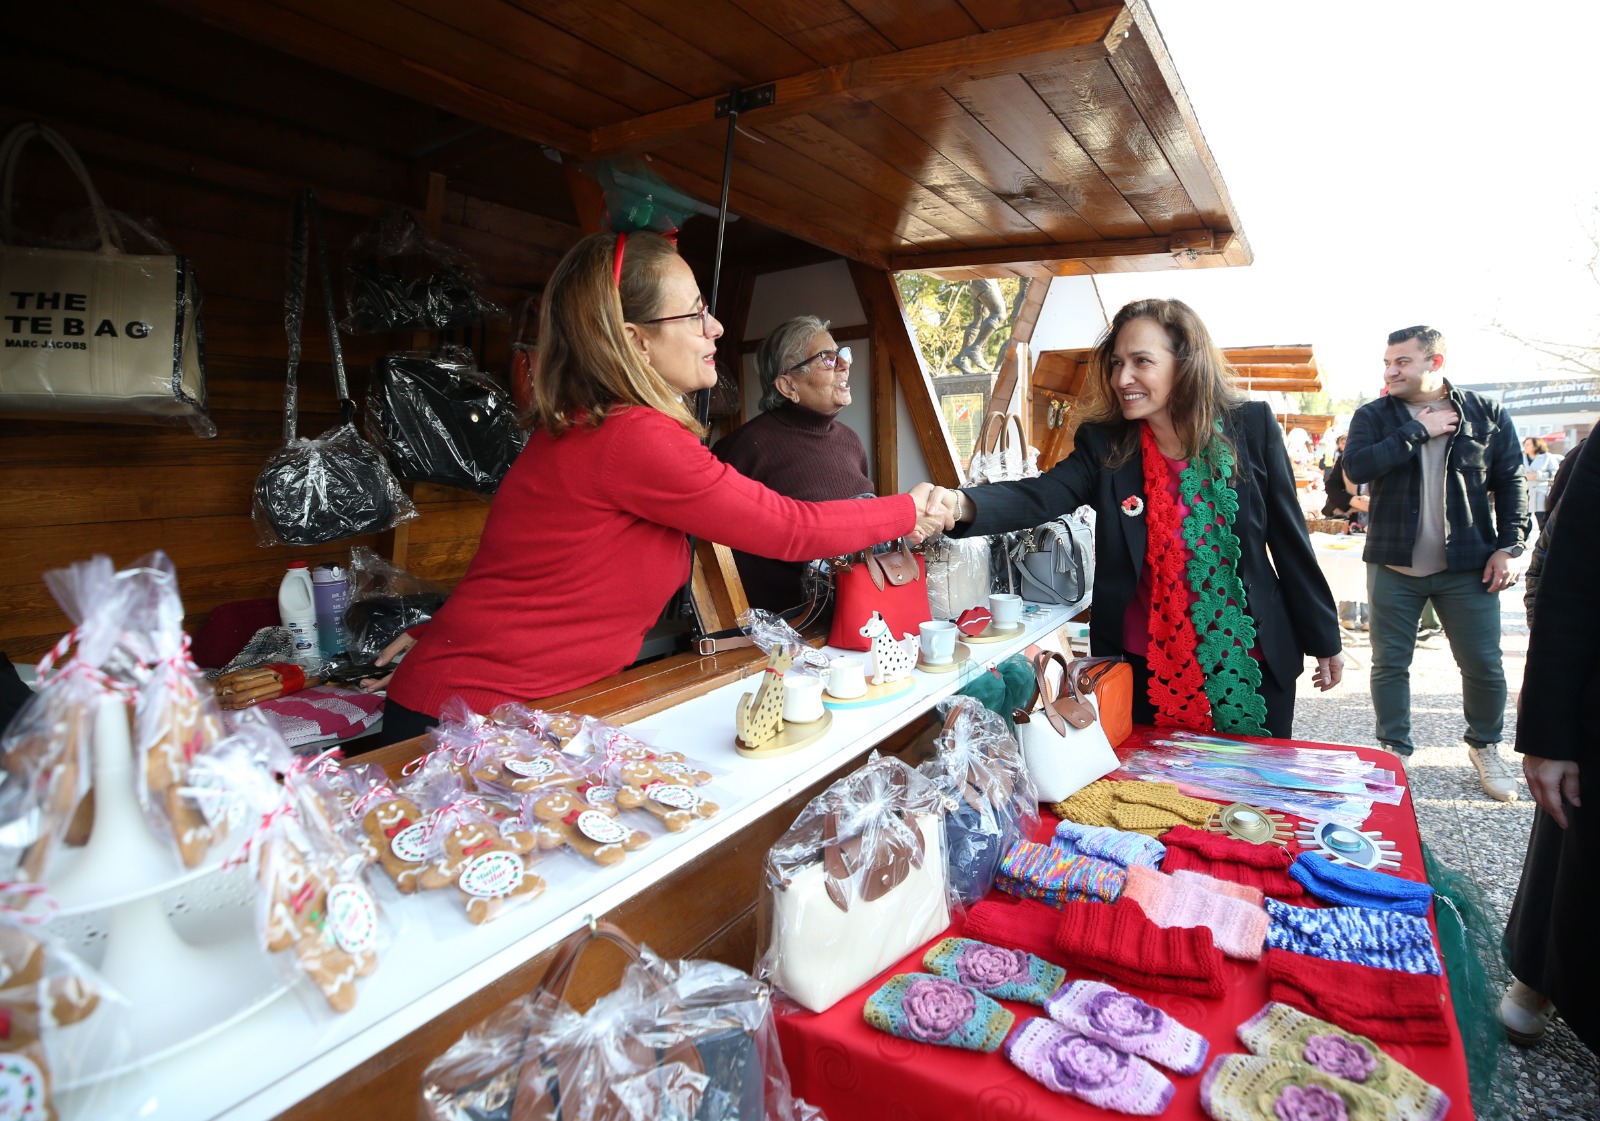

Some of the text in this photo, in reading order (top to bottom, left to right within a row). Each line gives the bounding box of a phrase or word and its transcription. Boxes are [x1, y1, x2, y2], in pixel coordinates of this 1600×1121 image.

[10, 292, 86, 311] THE
[5, 338, 86, 349] MARC JACOBS
[476, 864, 501, 880] Mutlu
